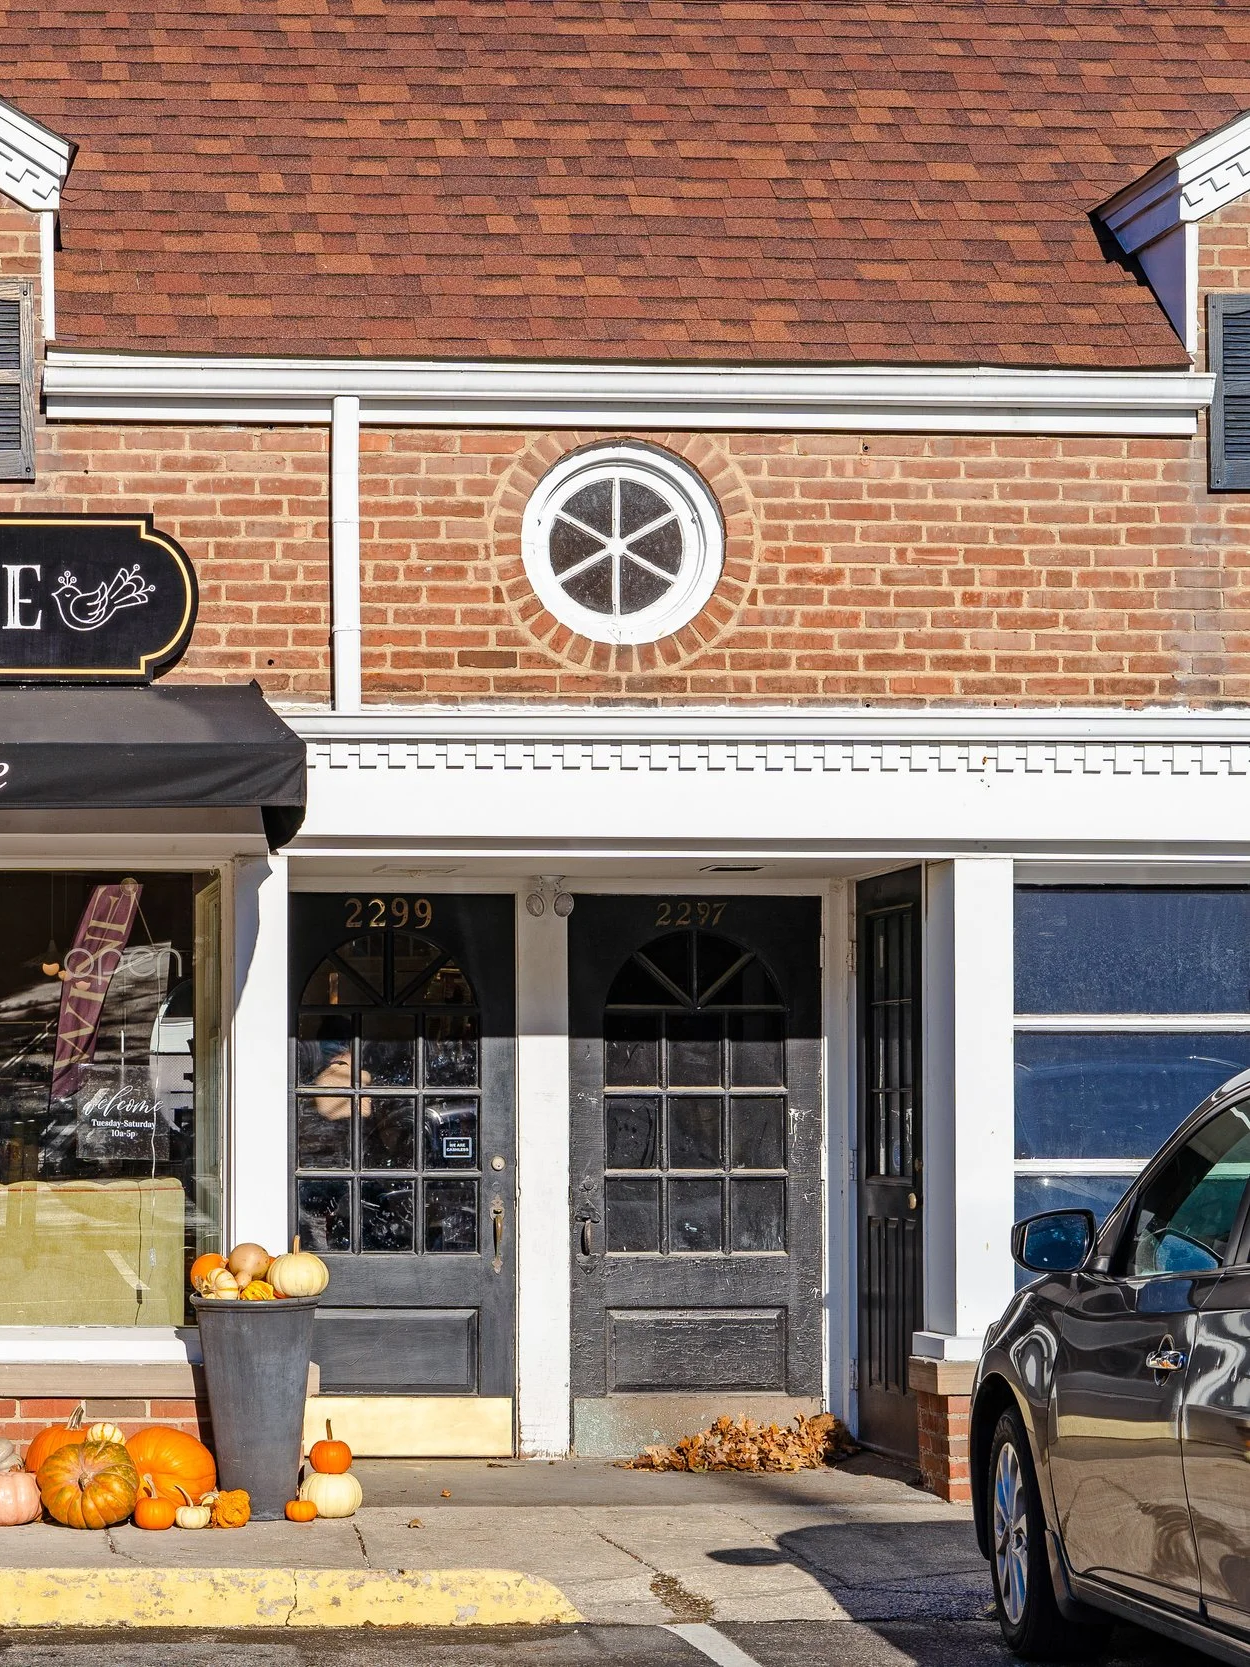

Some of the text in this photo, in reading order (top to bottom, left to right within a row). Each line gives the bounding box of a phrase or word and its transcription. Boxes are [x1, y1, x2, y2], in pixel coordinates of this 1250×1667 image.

[344, 897, 433, 930] 2299
[654, 901, 728, 927] 2297
[54, 885, 140, 1069] WINE
[82, 1084, 164, 1117] Welcome
[90, 1118, 156, 1130] Tuesday-Saturday
[111, 1130, 136, 1140] 10a-5p
